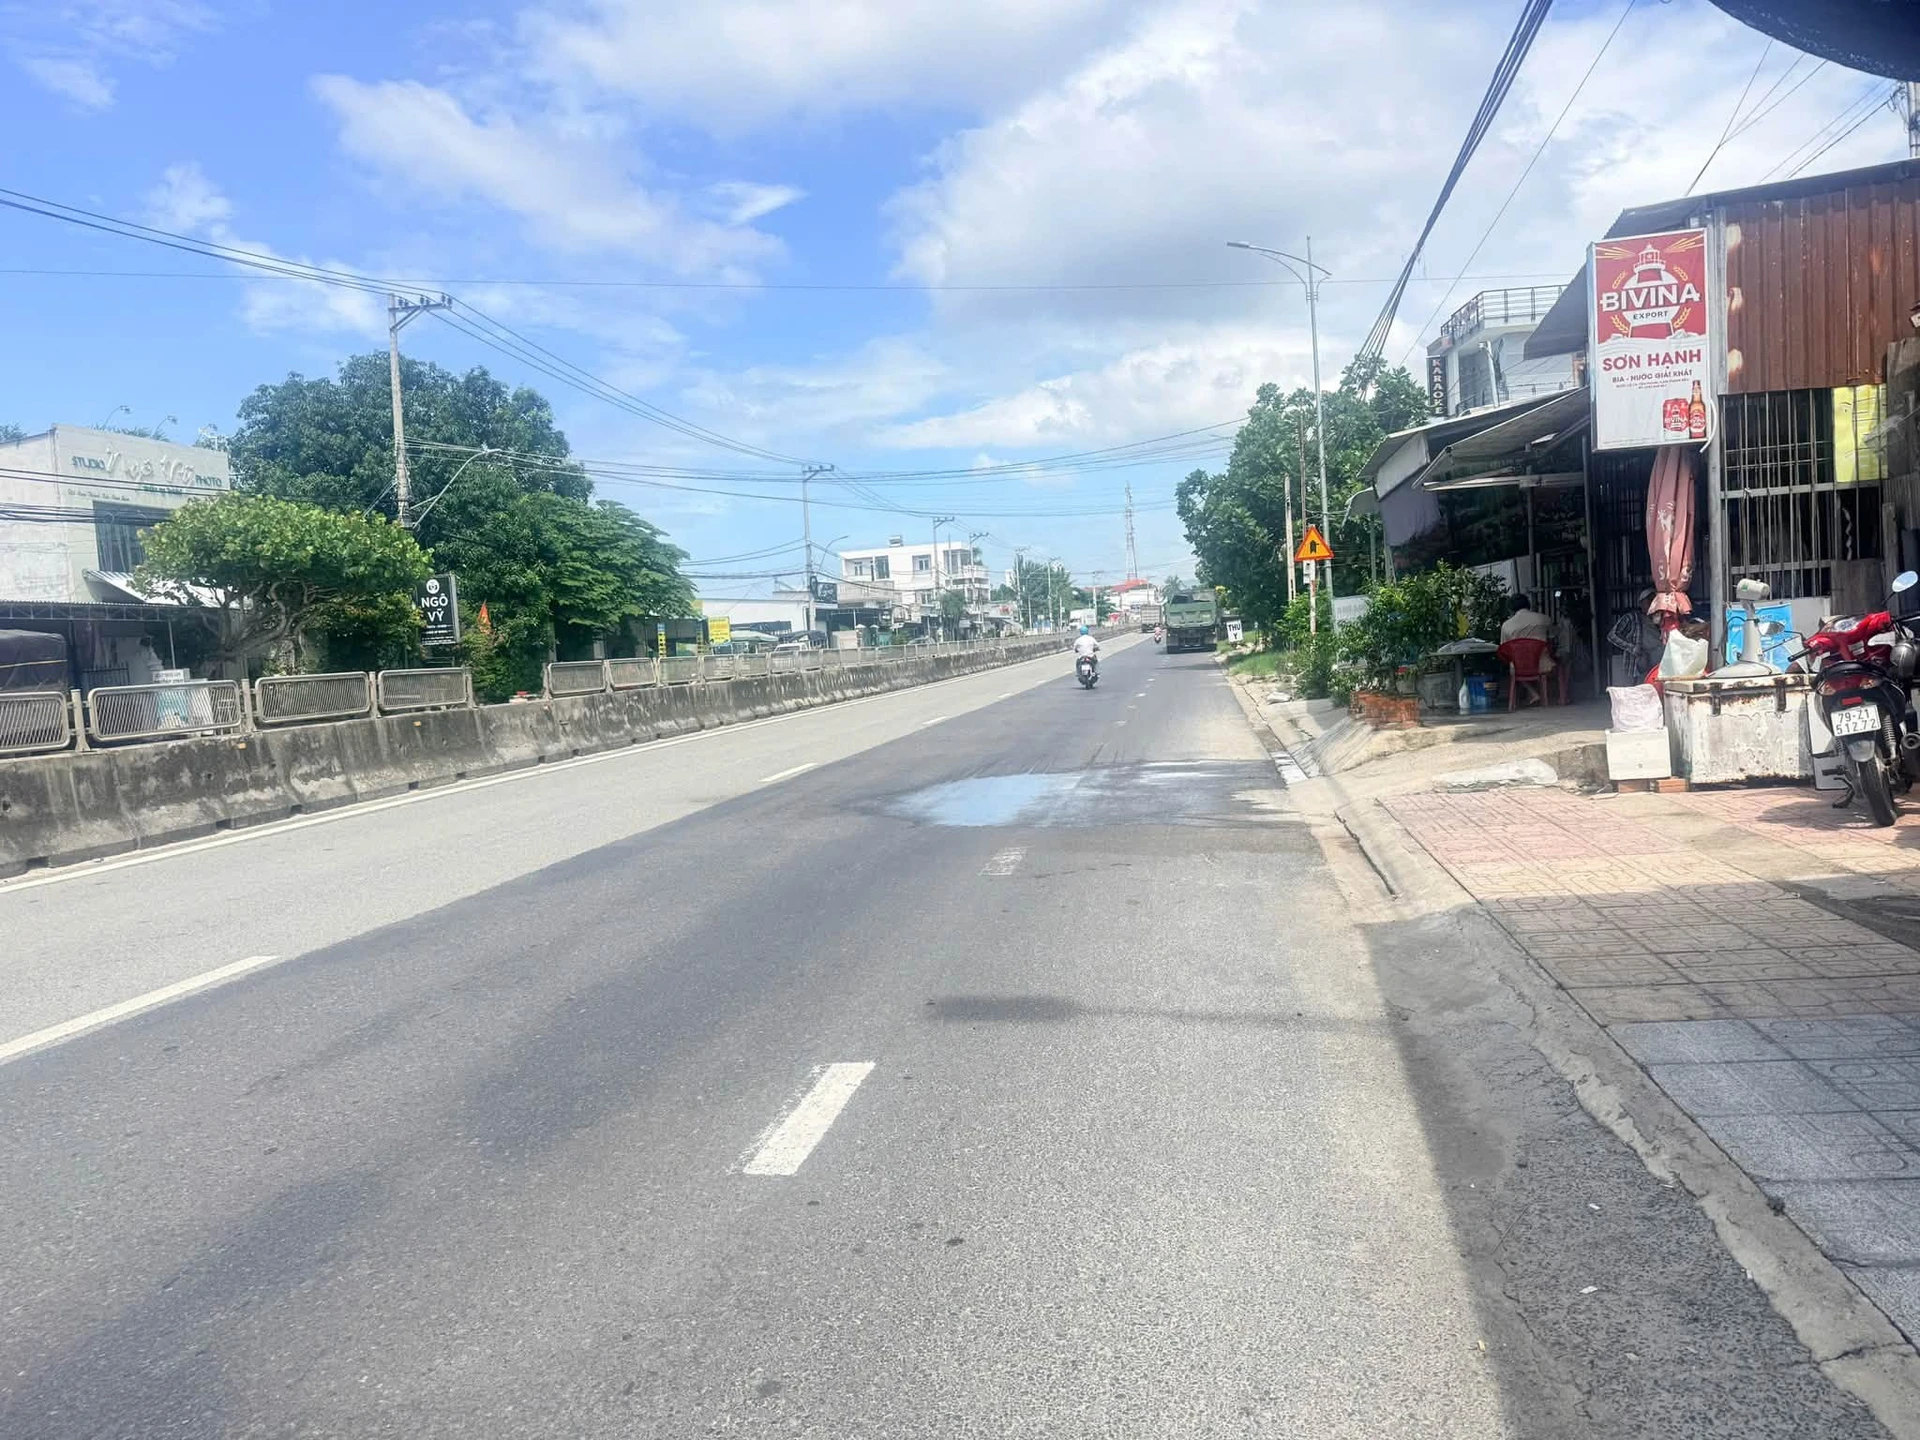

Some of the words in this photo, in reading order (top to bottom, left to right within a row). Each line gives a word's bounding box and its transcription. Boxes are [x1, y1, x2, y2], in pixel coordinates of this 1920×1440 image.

[1600, 283, 1700, 312] BIVINA
[1633, 311, 1668, 320] EXPORT
[1603, 354, 1641, 371] SƠN
[1648, 349, 1701, 369] HẠNH
[1432, 359, 1444, 414] KARAOKE
[71, 455, 106, 471] STUDIO
[195, 474, 222, 488] PHOTO
[421, 593, 448, 608] NGÔ
[1838, 709, 1870, 723] 79-Z1
[1836, 719, 1878, 735] 512.72
